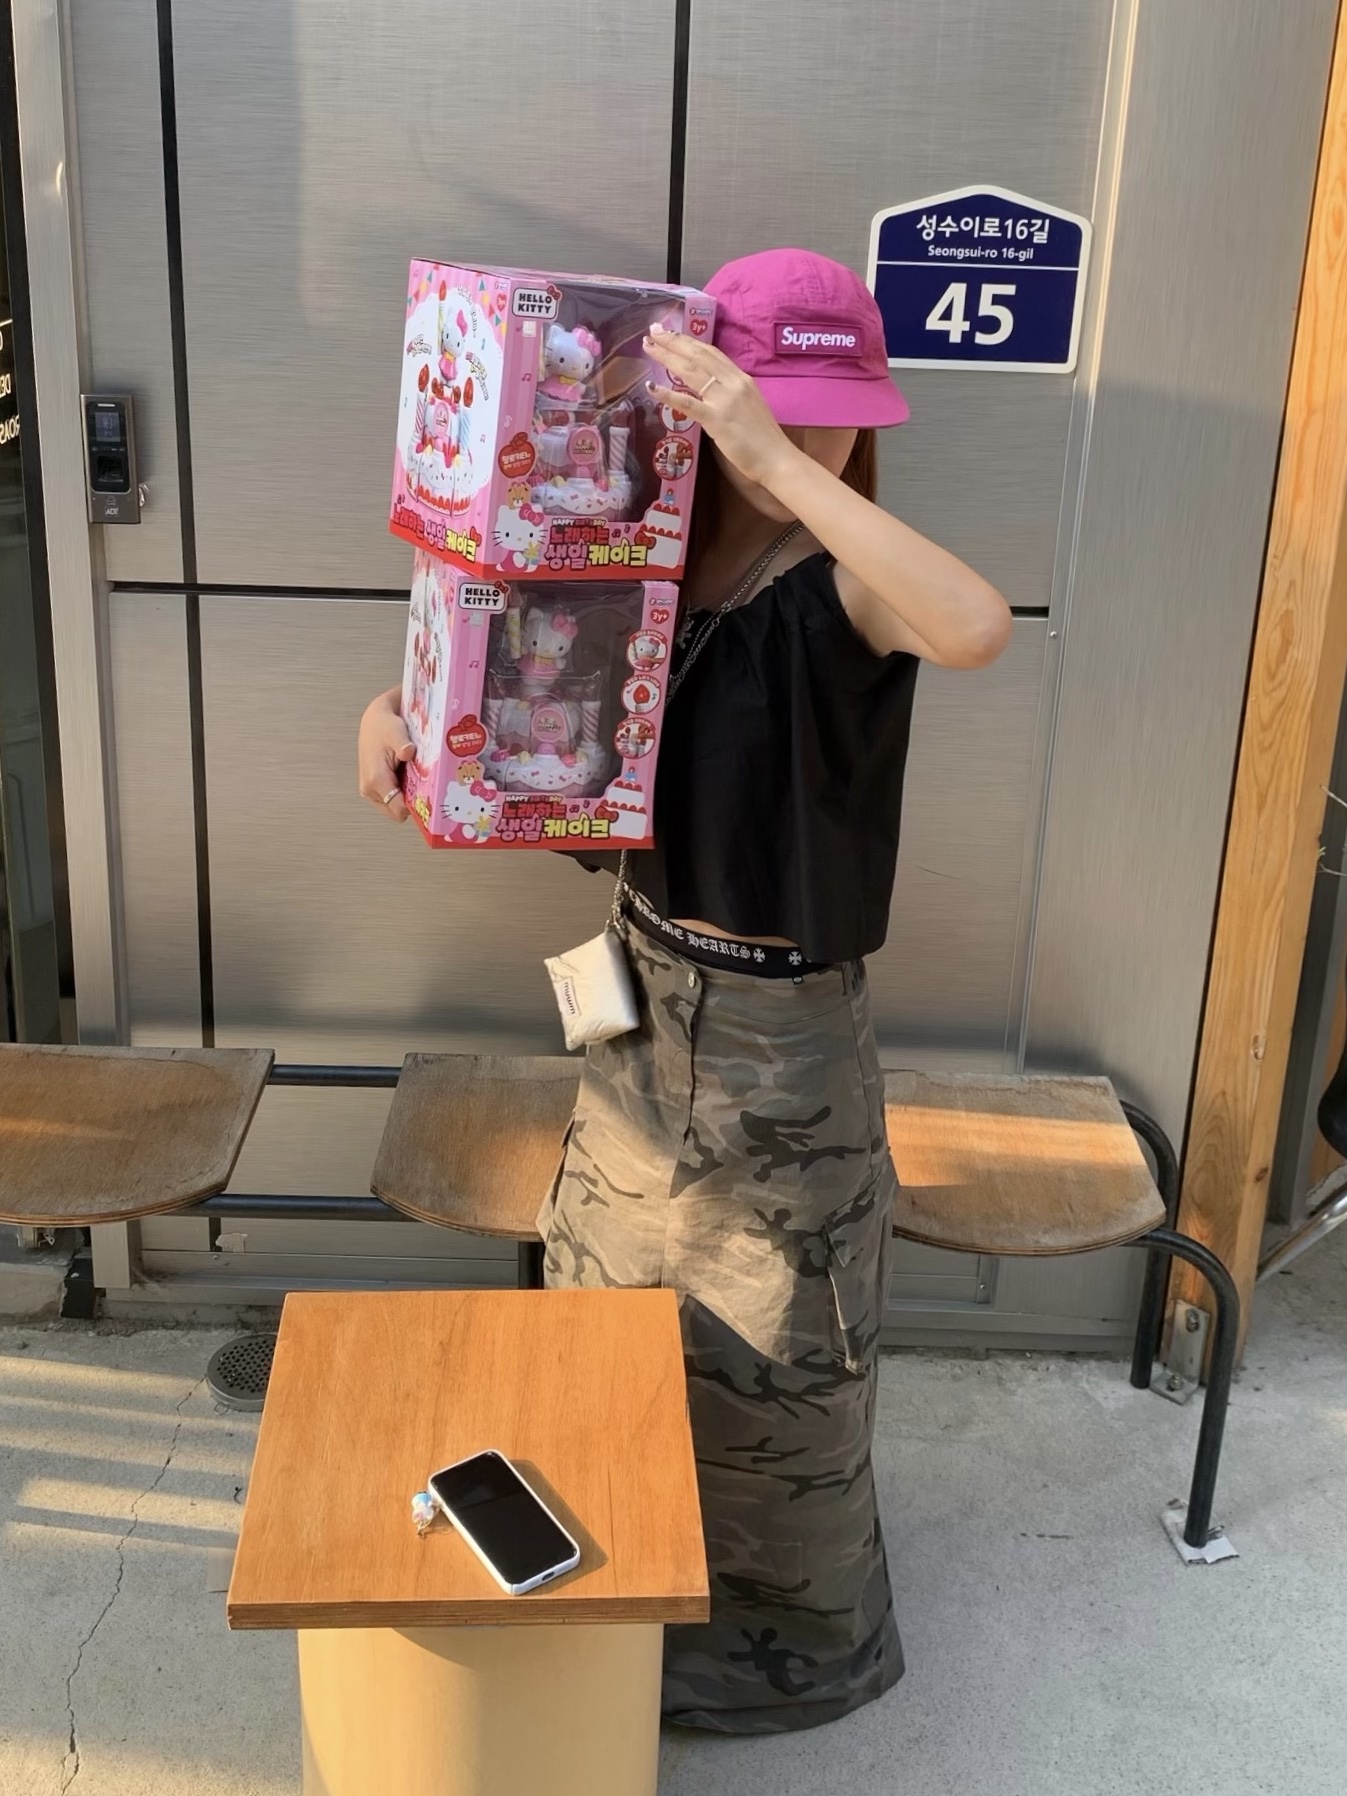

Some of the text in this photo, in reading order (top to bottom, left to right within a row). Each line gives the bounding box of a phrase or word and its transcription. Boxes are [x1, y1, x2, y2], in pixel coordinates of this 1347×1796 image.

[916, 214, 1050, 244] 성수이로16길
[927, 244, 1034, 262] Seongsui-ro 16-gil
[519, 293, 553, 304] HELLO
[517, 303, 552, 314] KITTY
[925, 282, 1017, 346] 45
[781, 326, 856, 351] Supreme
[393, 503, 425, 540] 노래하는
[552, 518, 576, 526] HAPPY
[550, 525, 610, 545] 노래하는
[465, 587, 500, 597] HELLO
[464, 597, 500, 606] KITTY
[651, 611, 668, 623] 3y+
[502, 801, 567, 819] 노래하는
[629, 888, 751, 959] CHROME HEARTS
